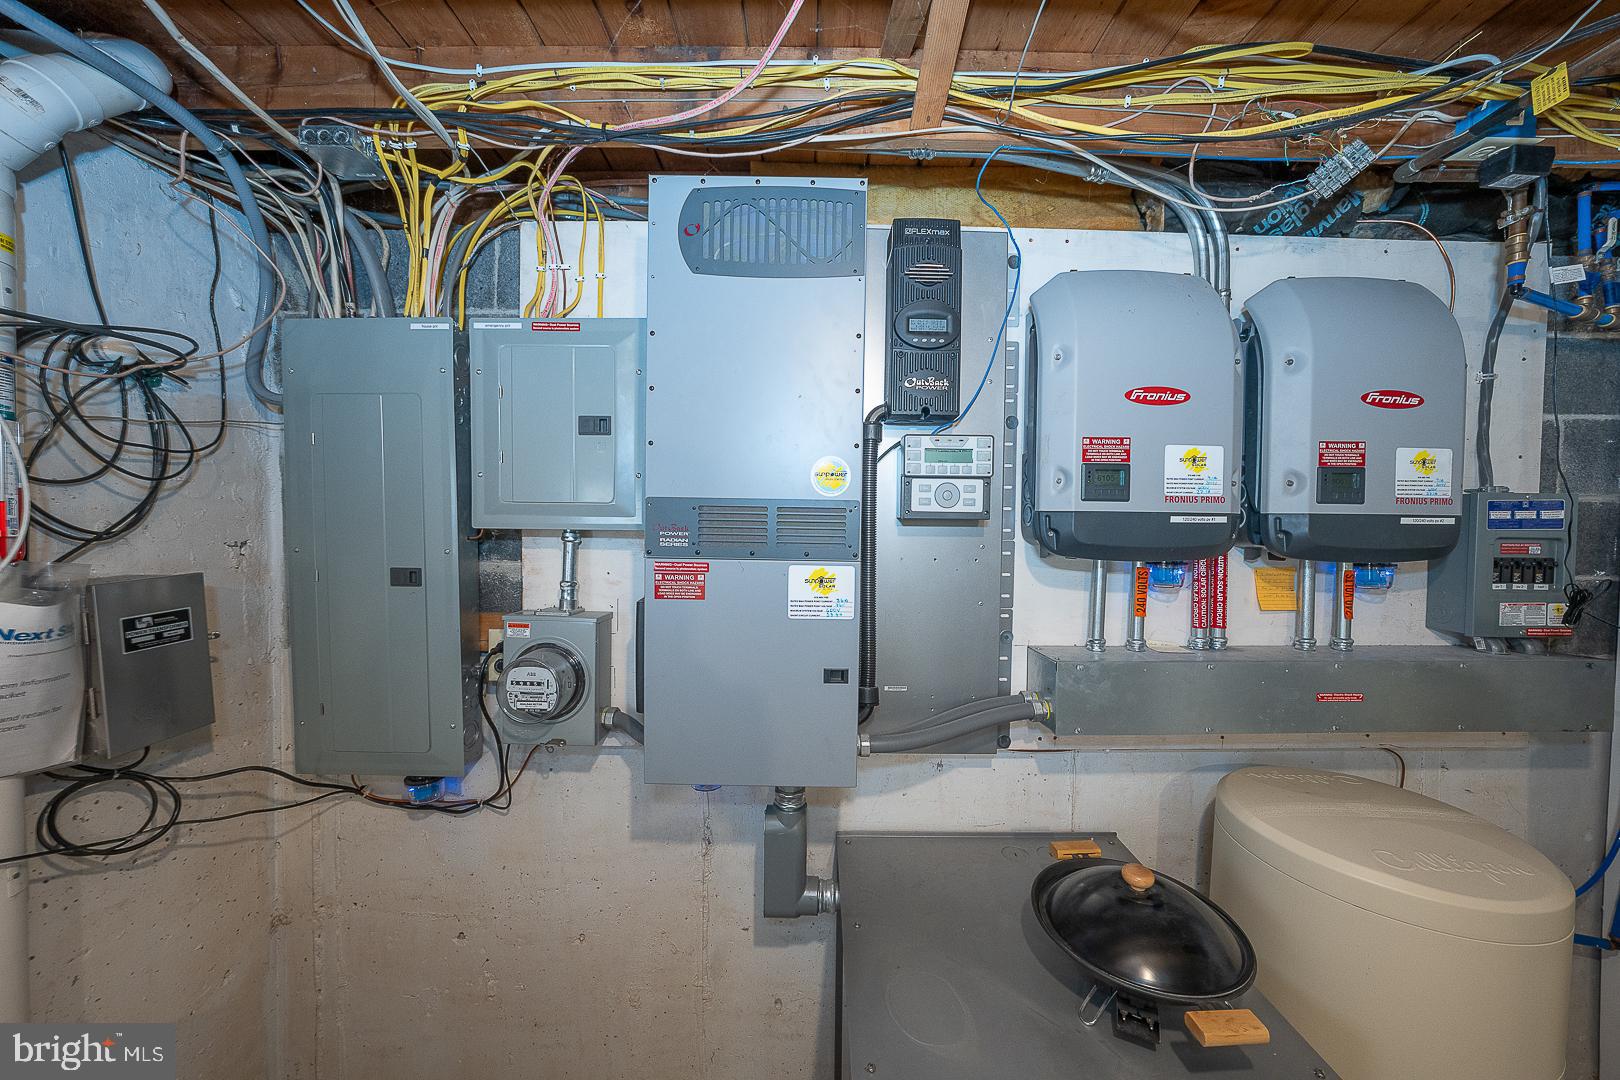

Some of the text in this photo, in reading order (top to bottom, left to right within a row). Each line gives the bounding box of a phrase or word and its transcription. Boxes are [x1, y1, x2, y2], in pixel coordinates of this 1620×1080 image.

[904, 377, 949, 387] OutBack
[1130, 390, 1186, 400] Fronius
[1366, 393, 1420, 404] Fronius
[1137, 570, 1148, 612] 240 VOLTS
[0, 628, 54, 640] Next
[1369, 850, 1536, 886] Culligan
